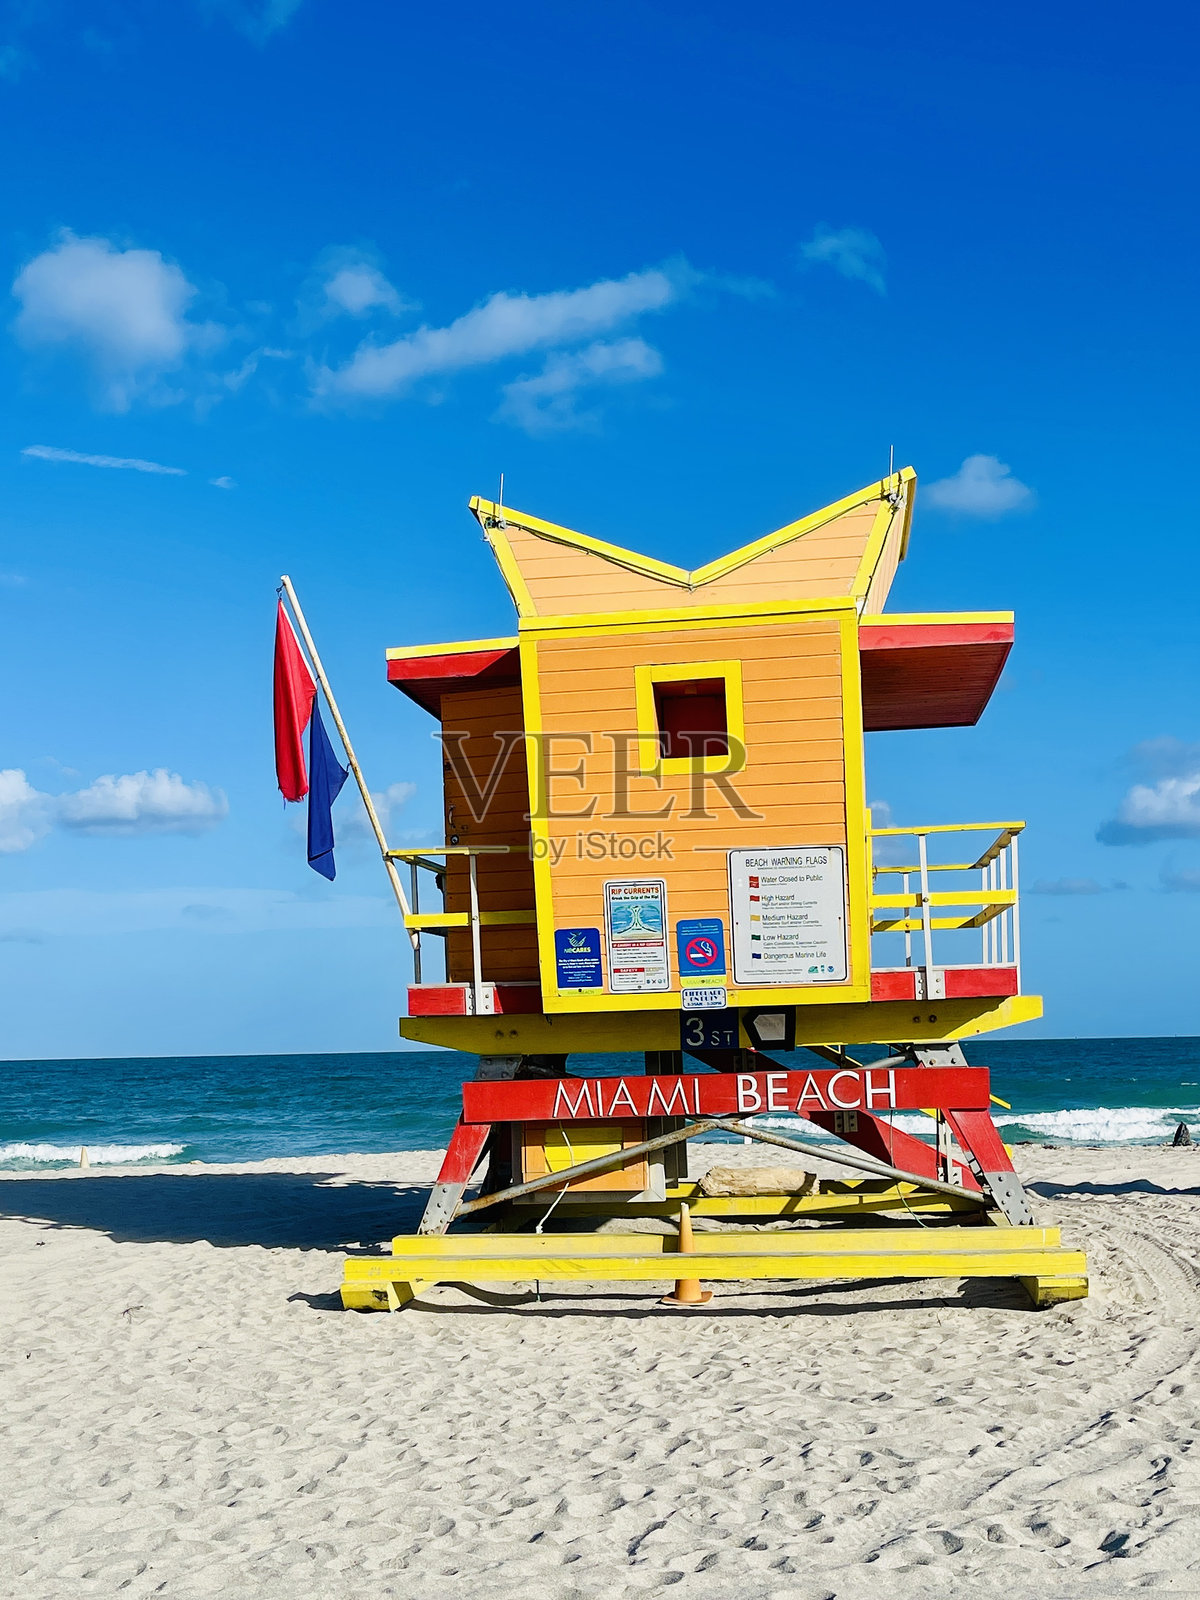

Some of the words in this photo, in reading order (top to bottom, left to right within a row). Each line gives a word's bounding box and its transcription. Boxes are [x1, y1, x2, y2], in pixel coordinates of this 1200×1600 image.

[745, 858, 768, 867] BEACH
[771, 856, 803, 866] WARNING
[805, 855, 828, 865] FLAGS
[761, 895, 774, 903] High
[764, 952, 795, 960] Dangerous
[795, 951, 815, 959] Marine
[686, 1017, 705, 1046] 3
[710, 1030, 734, 1046] ST
[552, 1077, 701, 1119] MIAMI
[736, 1069, 896, 1113] BEACH
